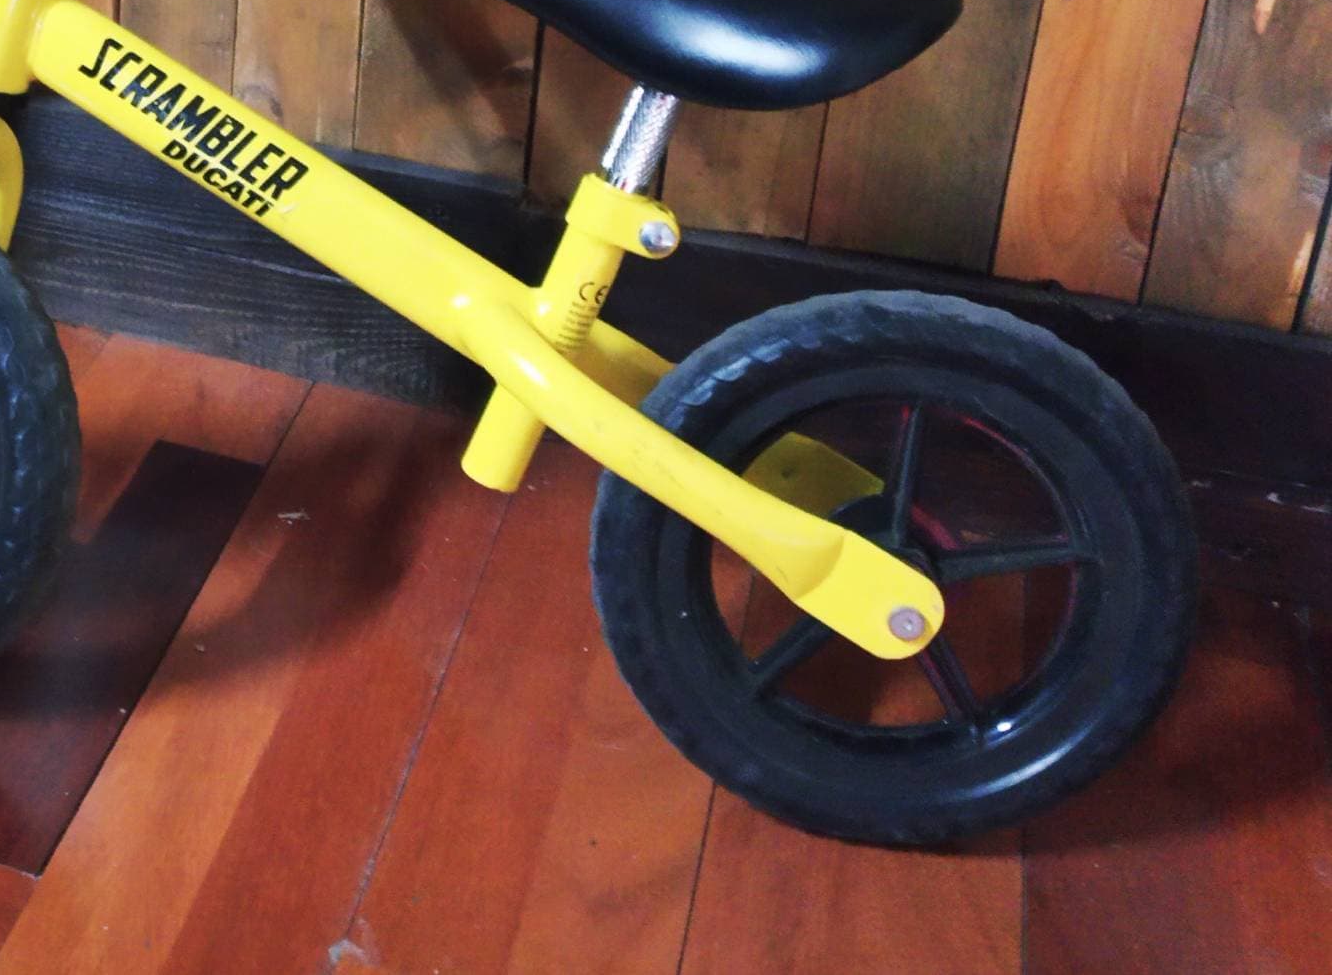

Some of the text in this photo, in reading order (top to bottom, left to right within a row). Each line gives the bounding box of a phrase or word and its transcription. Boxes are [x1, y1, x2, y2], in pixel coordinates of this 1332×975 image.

[78, 38, 309, 200] SCRAMBLER
[161, 139, 274, 218] DUCATI
[579, 281, 610, 305] CE
